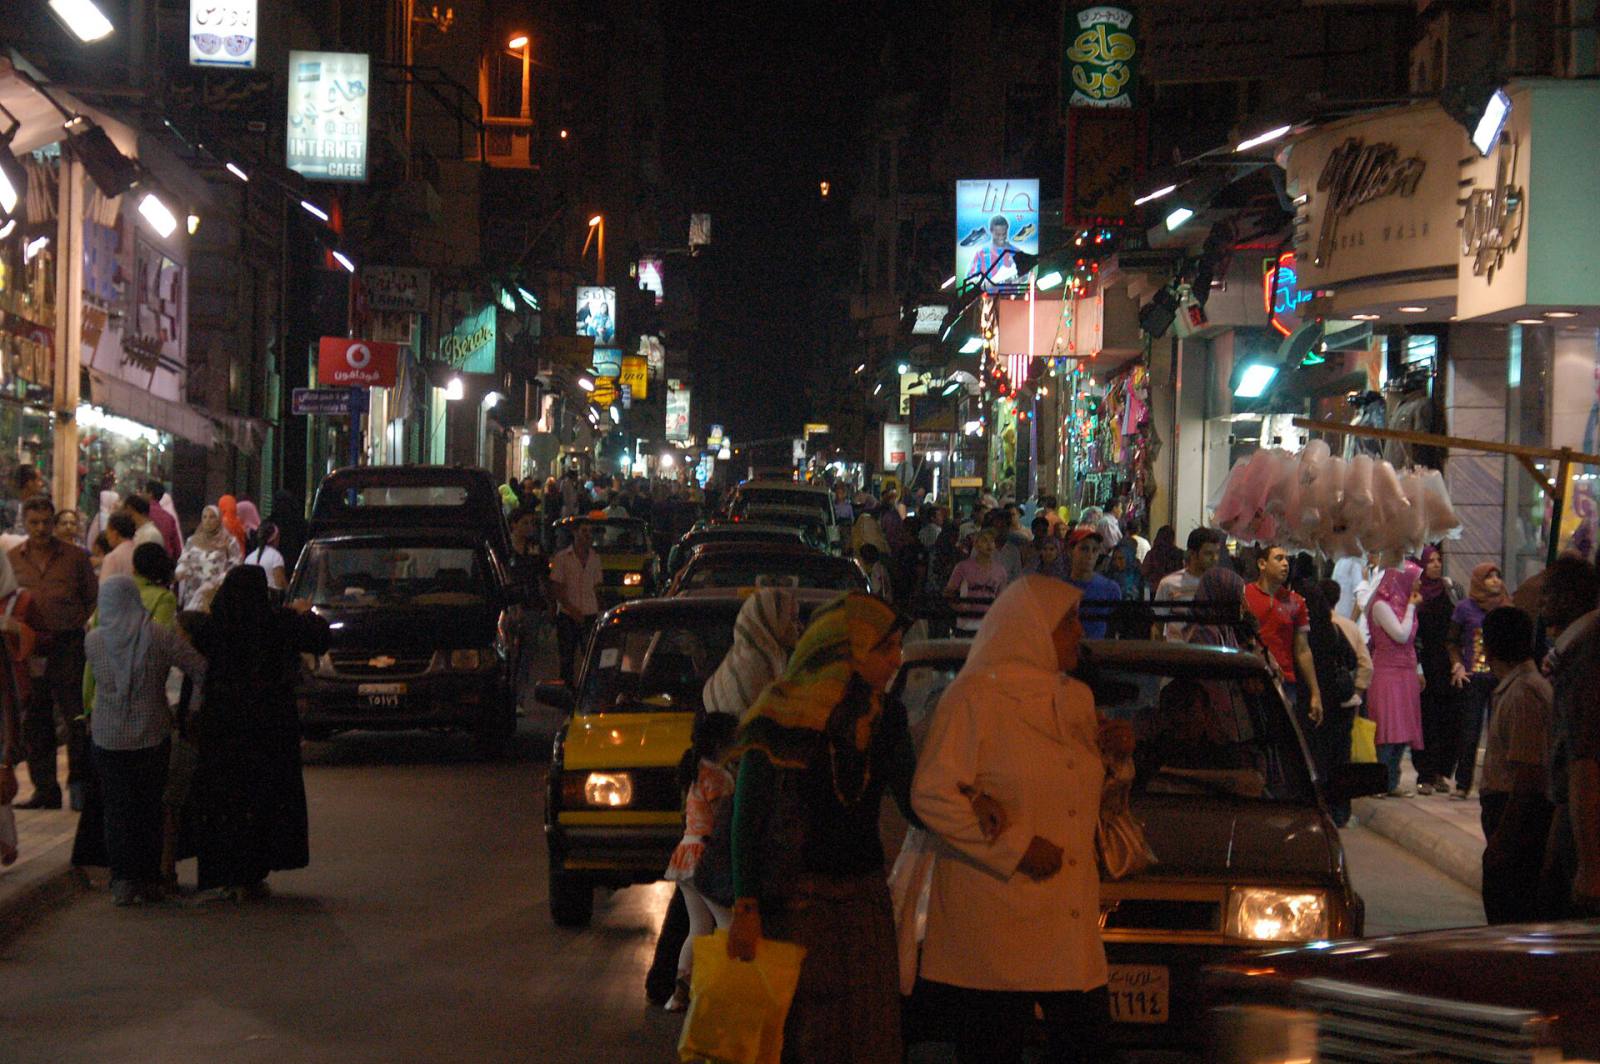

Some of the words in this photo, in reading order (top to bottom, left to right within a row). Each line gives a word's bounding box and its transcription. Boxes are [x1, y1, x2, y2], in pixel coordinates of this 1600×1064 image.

[289, 139, 363, 159] INTERNET
[328, 162, 362, 177] CAFEE
[333, 369, 380, 382] فودافون
